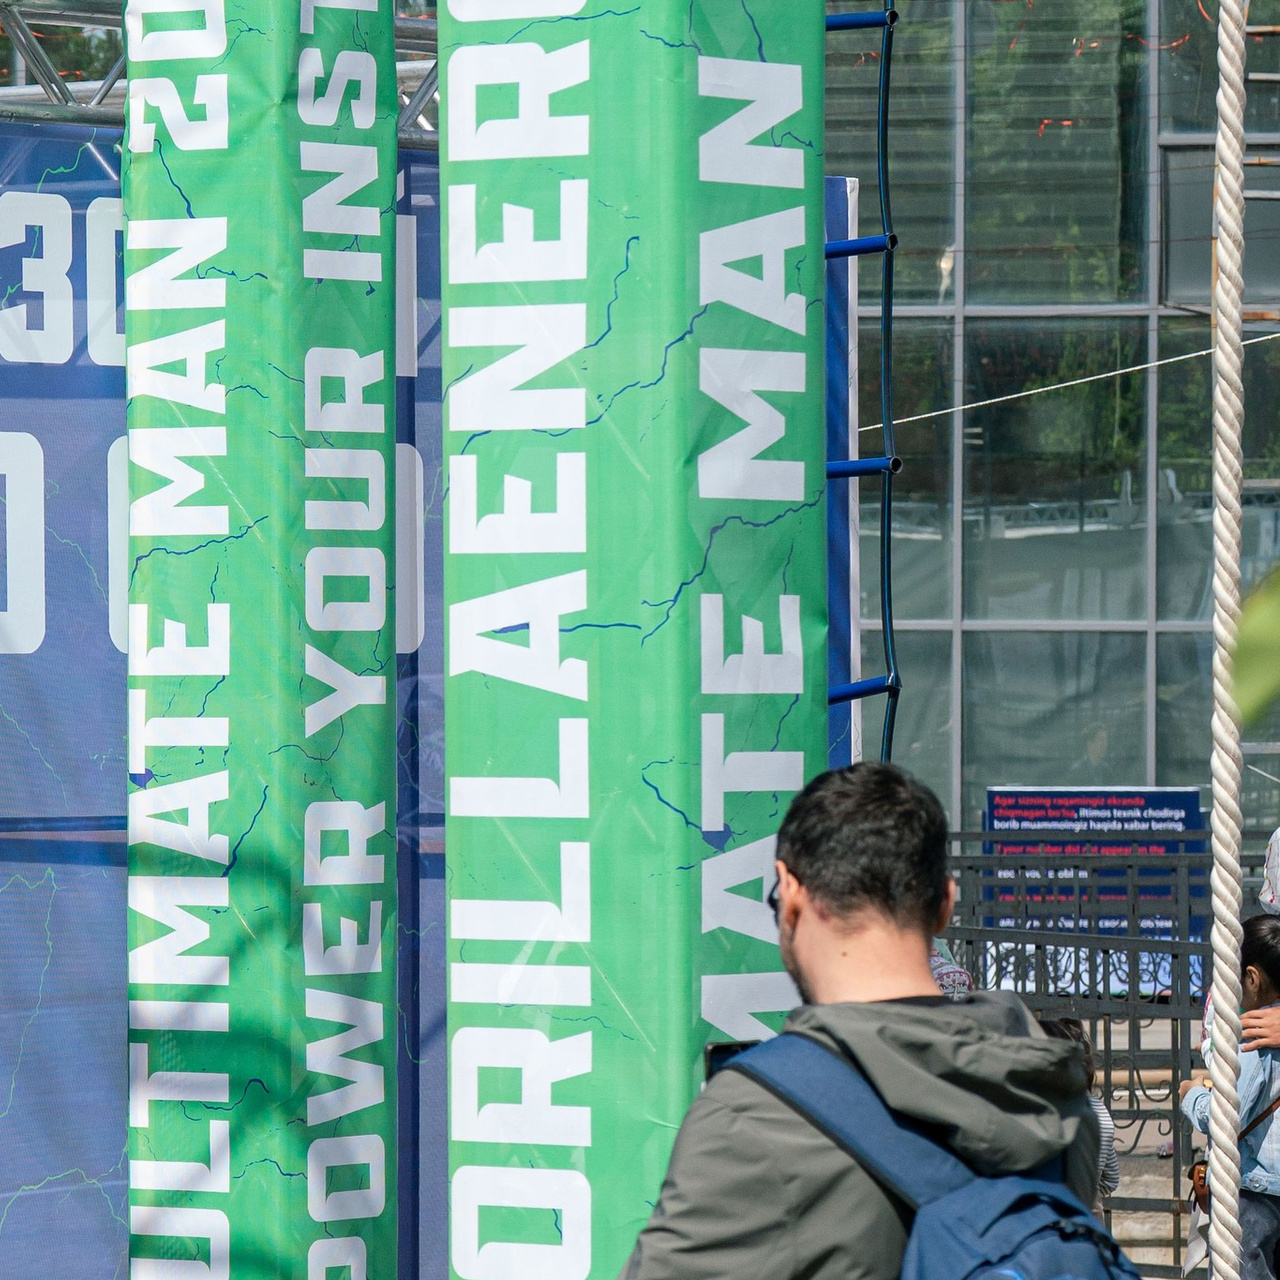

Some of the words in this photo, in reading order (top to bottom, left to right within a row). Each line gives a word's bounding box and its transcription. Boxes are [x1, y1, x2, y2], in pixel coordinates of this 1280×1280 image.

[124, 216, 228, 537] MAN
[696, 61, 807, 502] MAN
[304, 346, 387, 738] YOUR
[1089, 819, 1122, 832] haqida
[1123, 819, 1150, 831] xabar
[1112, 807, 1142, 819] texnik
[1143, 807, 1186, 821] chodirga
